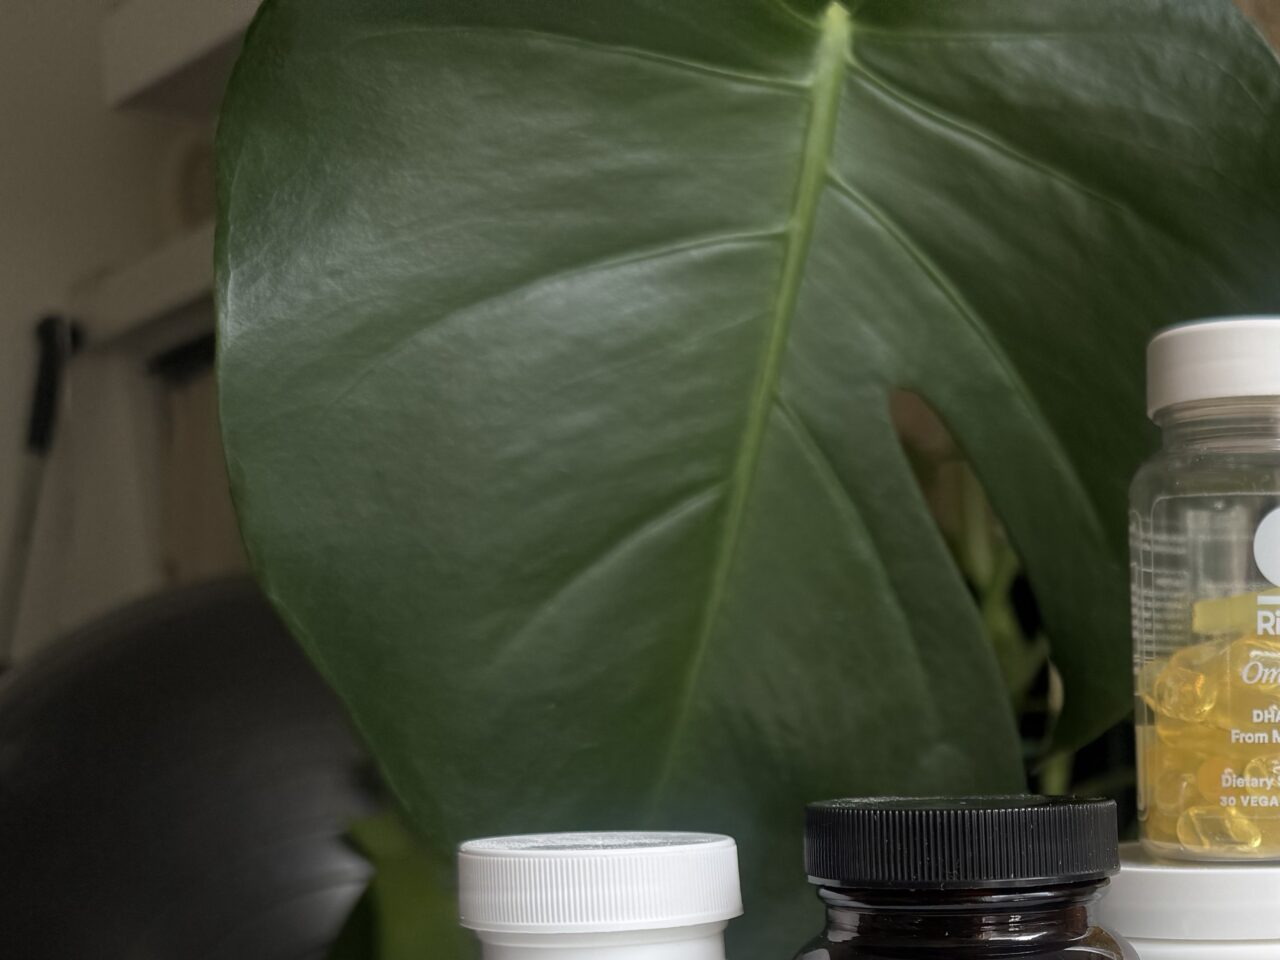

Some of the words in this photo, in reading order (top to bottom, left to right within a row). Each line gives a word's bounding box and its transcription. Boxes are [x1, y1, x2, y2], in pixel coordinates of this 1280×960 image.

[1231, 729, 1268, 744] From
[1221, 772, 1273, 790] Dietary
[1219, 796, 1236, 807] 30
